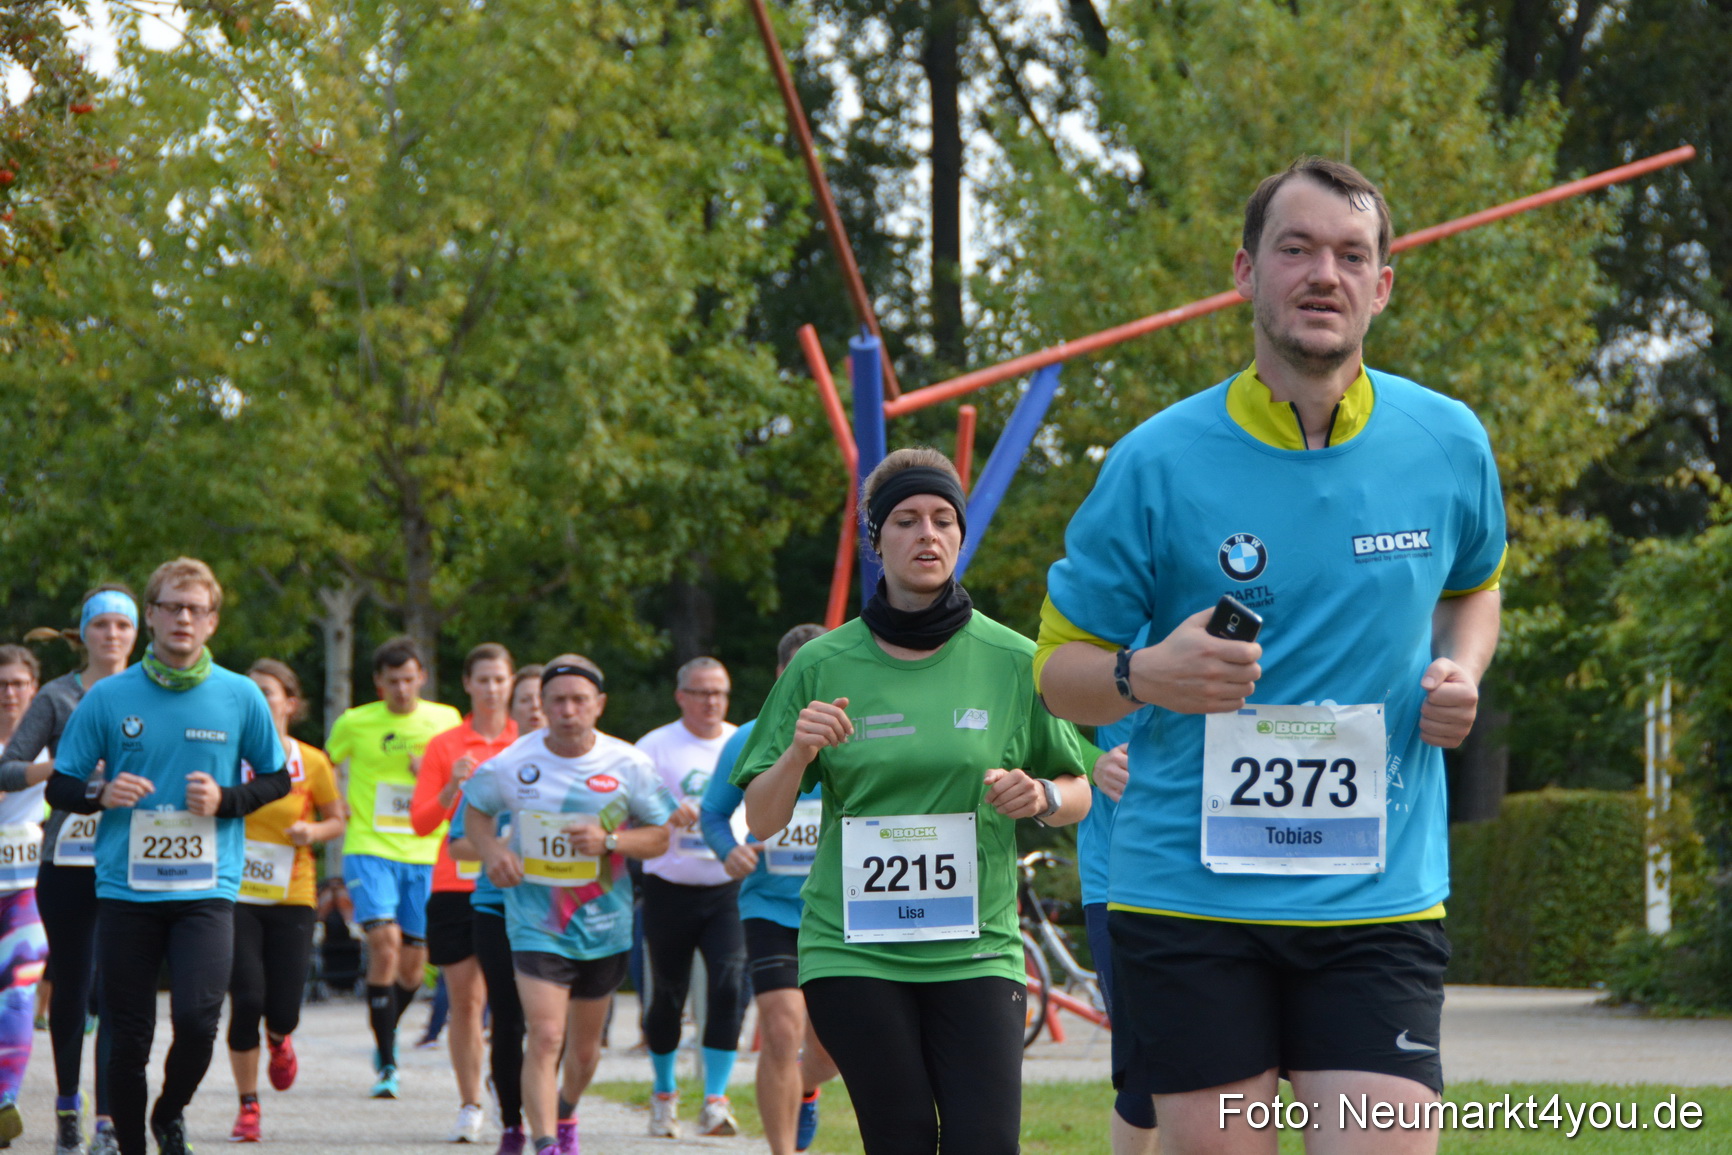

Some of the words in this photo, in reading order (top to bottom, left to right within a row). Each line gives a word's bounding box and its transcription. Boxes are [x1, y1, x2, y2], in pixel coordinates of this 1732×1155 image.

[1221, 534, 1262, 553] BMW
[1353, 530, 1431, 555] BOCK
[1244, 597, 1275, 608] markt
[966, 710, 987, 720] AOK
[1275, 721, 1336, 735] BOCK
[1230, 757, 1358, 808] 2373
[1211, 799, 1219, 809] D
[777, 825, 820, 847] 248
[892, 826, 937, 838] BOCK
[1265, 827, 1323, 845] Tobias
[0, 844, 37, 863] 918
[143, 836, 203, 859] 2233
[157, 867, 187, 877] Nathan
[863, 854, 957, 892] 2215
[898, 906, 925, 919] Lisa
